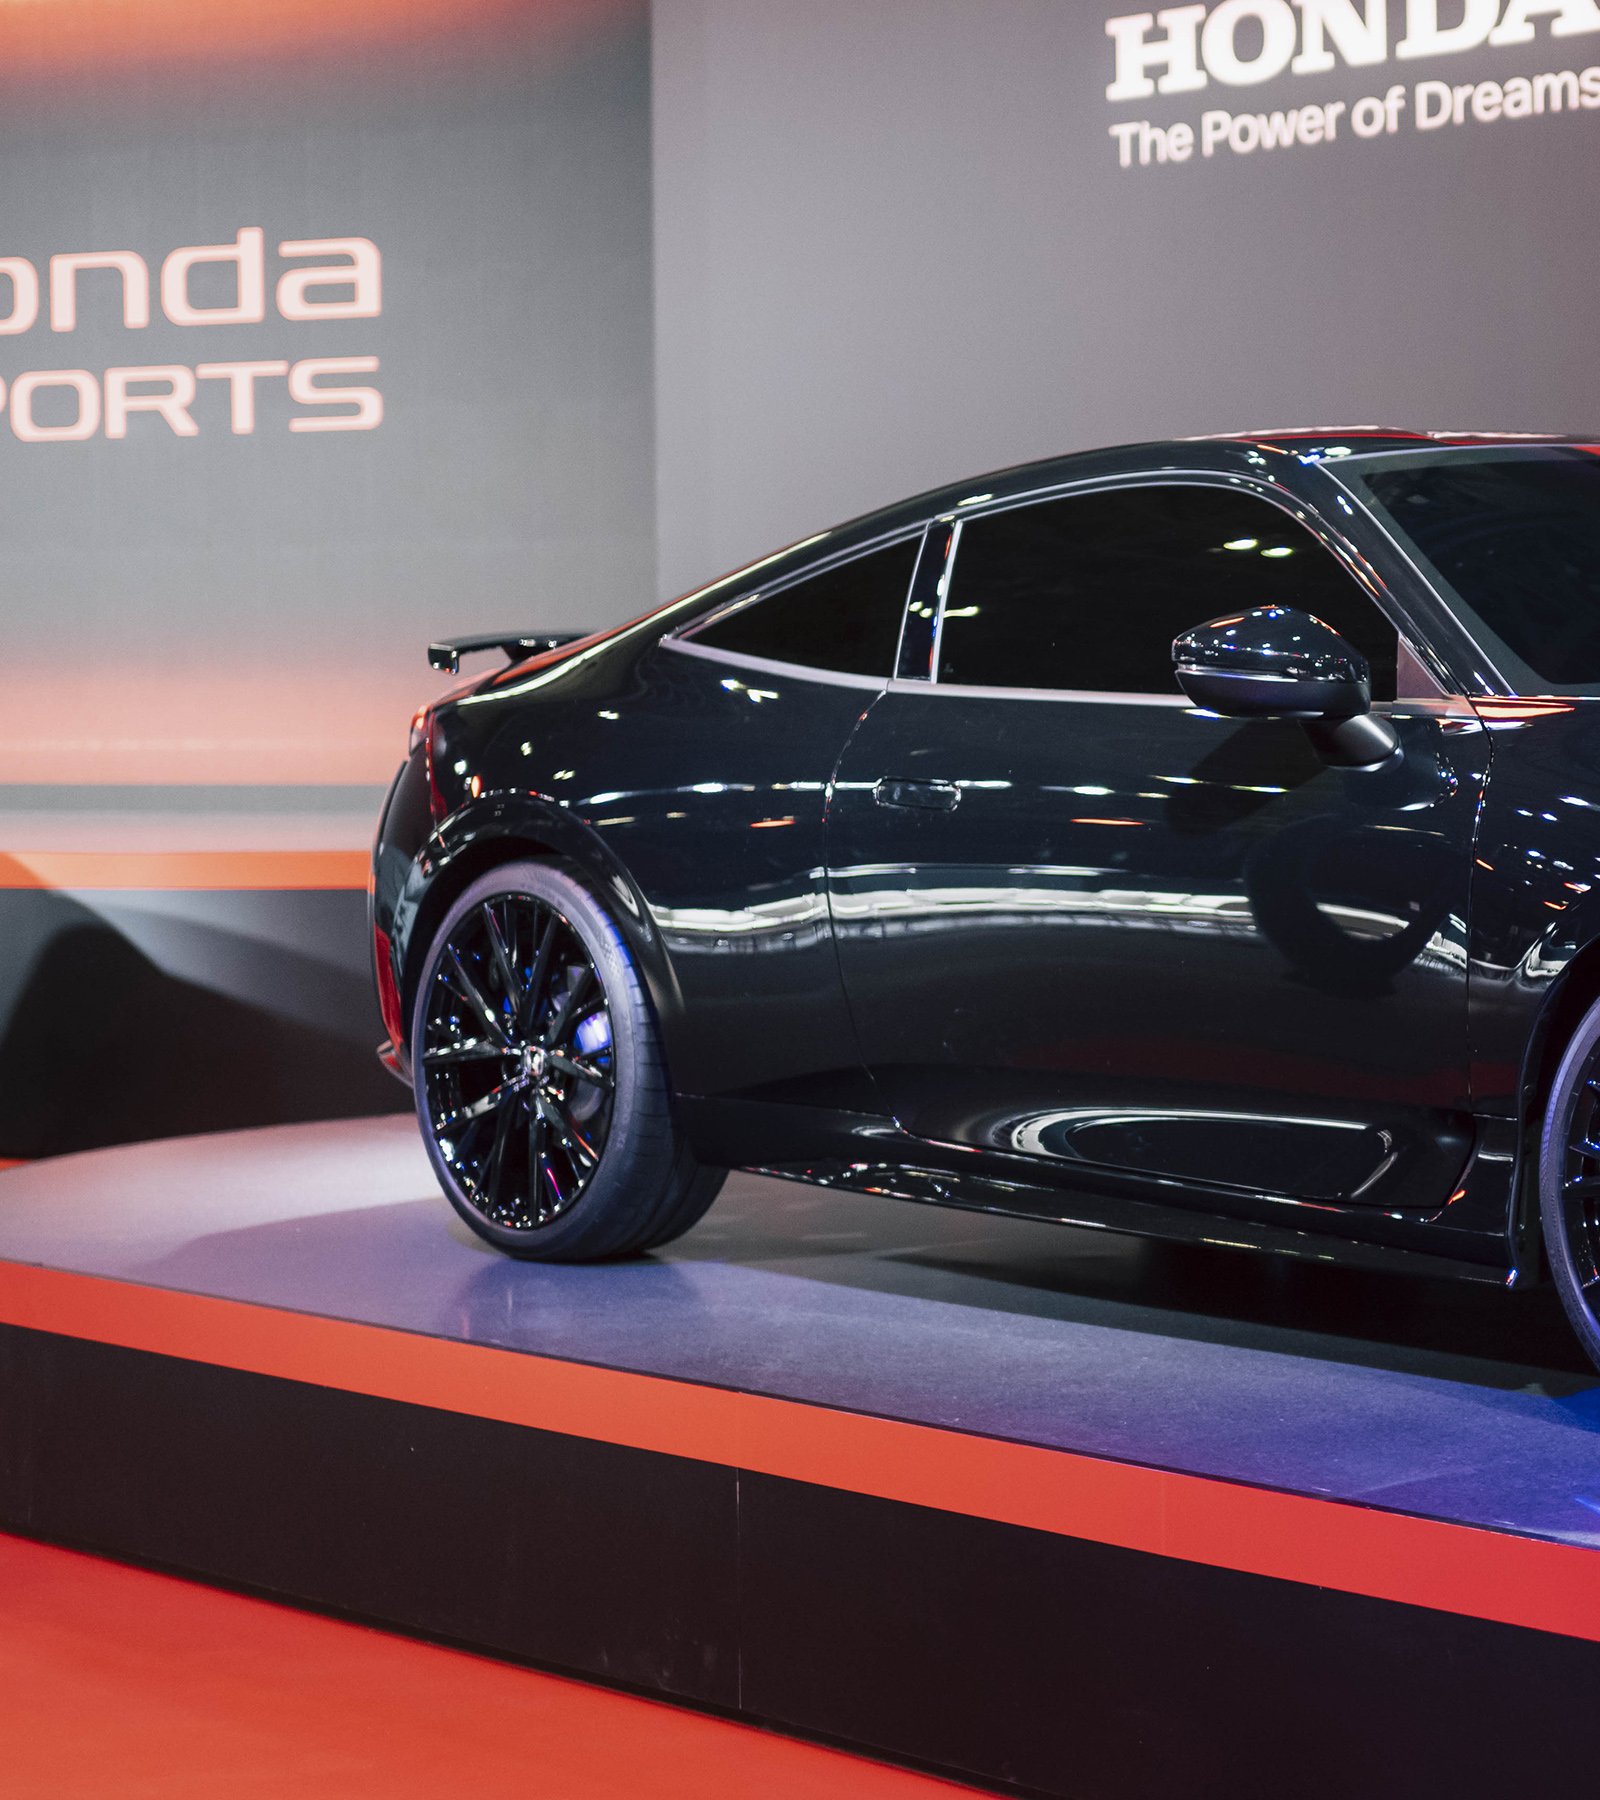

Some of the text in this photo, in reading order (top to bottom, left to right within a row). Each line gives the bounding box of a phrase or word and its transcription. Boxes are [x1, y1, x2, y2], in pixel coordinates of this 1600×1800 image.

[1108, 120, 1195, 168] The
[1201, 101, 1346, 157] Power
[1351, 84, 1406, 138] of
[0, 356, 383, 442] ORTS
